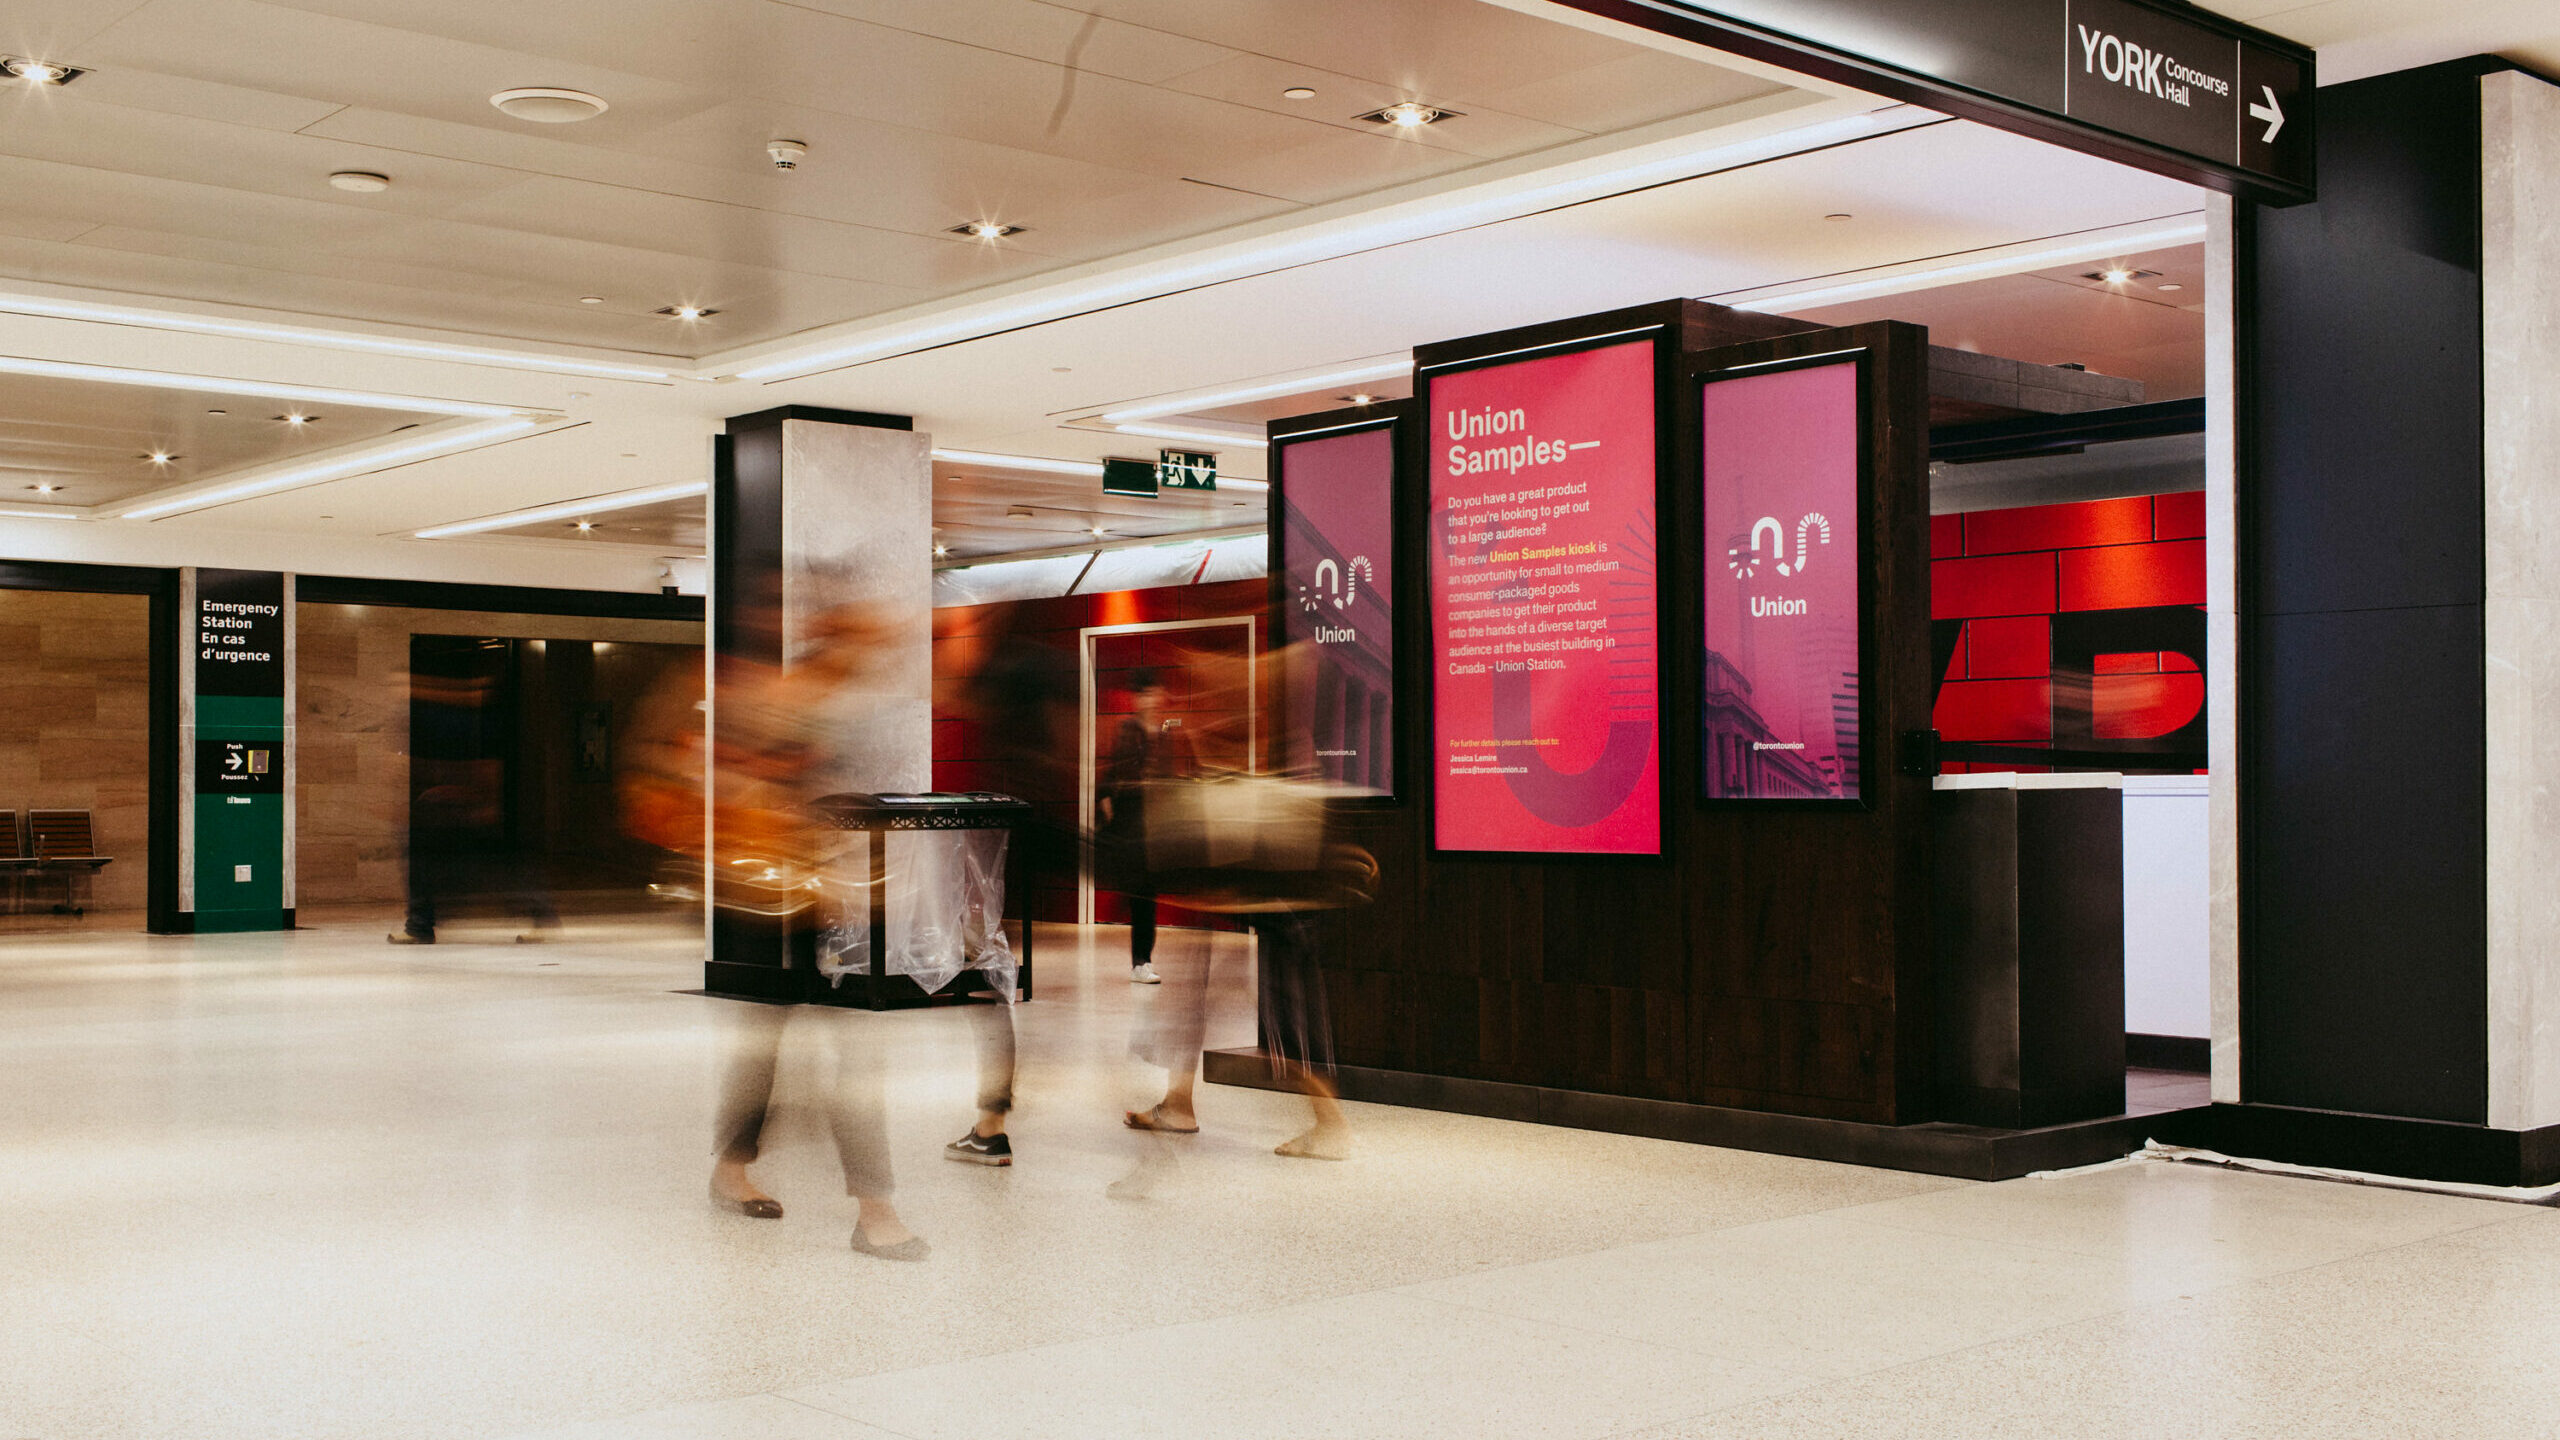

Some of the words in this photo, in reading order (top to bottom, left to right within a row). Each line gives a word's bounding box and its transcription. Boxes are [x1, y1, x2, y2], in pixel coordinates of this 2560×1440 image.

[2078, 24, 2164, 99] YORK
[2165, 57, 2229, 97] Concourse
[2166, 81, 2190, 107] Hall
[1448, 405, 1525, 441] Union
[1448, 497, 1462, 509] Do
[1464, 496, 1481, 509] you
[1484, 493, 1507, 506] have
[1509, 493, 1516, 502] a
[1518, 487, 1545, 502] great
[1547, 481, 1587, 499] product
[1448, 515, 1467, 527] that
[1501, 507, 1538, 521] looking
[1541, 505, 1551, 517] to
[1553, 503, 1570, 518] get
[1573, 500, 1590, 513] out
[1448, 534, 1458, 545] to
[1460, 534, 1467, 544] a
[1468, 529, 1494, 545] large
[1496, 523, 1547, 540] audience?
[1449, 555, 1466, 567] The
[1468, 554, 1488, 565] new
[1490, 549, 1519, 563] Union
[1521, 544, 1566, 561] Samples
[1568, 541, 1597, 555] kiosk
[1599, 541, 1608, 552] is
[1448, 575, 1460, 585] an
[1462, 568, 1517, 586] opportunity
[1519, 565, 1533, 578] for
[1535, 562, 1561, 576] small
[1564, 563, 1574, 574] to
[1576, 559, 1619, 573] medium
[1449, 583, 1546, 603] consumer-packaged
[1548, 581, 1580, 597] goods
[202, 600, 278, 617] Emergency
[1449, 606, 1501, 622] companies
[1502, 606, 1512, 617] to
[1514, 604, 1530, 620] get
[1533, 601, 1554, 615] their
[1557, 599, 1597, 614] product
[1751, 595, 1807, 617] Union
[202, 616, 252, 629] Station
[1449, 627, 1467, 639] into
[1469, 625, 1484, 637] the
[1486, 622, 1516, 636] hands
[1518, 622, 1528, 634] of
[1529, 624, 1536, 634] a
[1537, 619, 1574, 634] diverse
[1576, 616, 1607, 633] target
[201, 632, 219, 644] En
[222, 635, 246, 645] cas
[1315, 625, 1356, 644] Union
[1449, 644, 1492, 657] audience
[1493, 643, 1504, 654] at
[1506, 641, 1521, 653] the
[1523, 639, 1560, 653] busiest
[1561, 636, 1603, 652] building
[1605, 635, 1616, 648] in
[1449, 661, 1486, 675] Canada
[1496, 659, 1525, 673] Union
[1527, 657, 1567, 671] Station.
[1753, 741, 1804, 750] @torontounion
